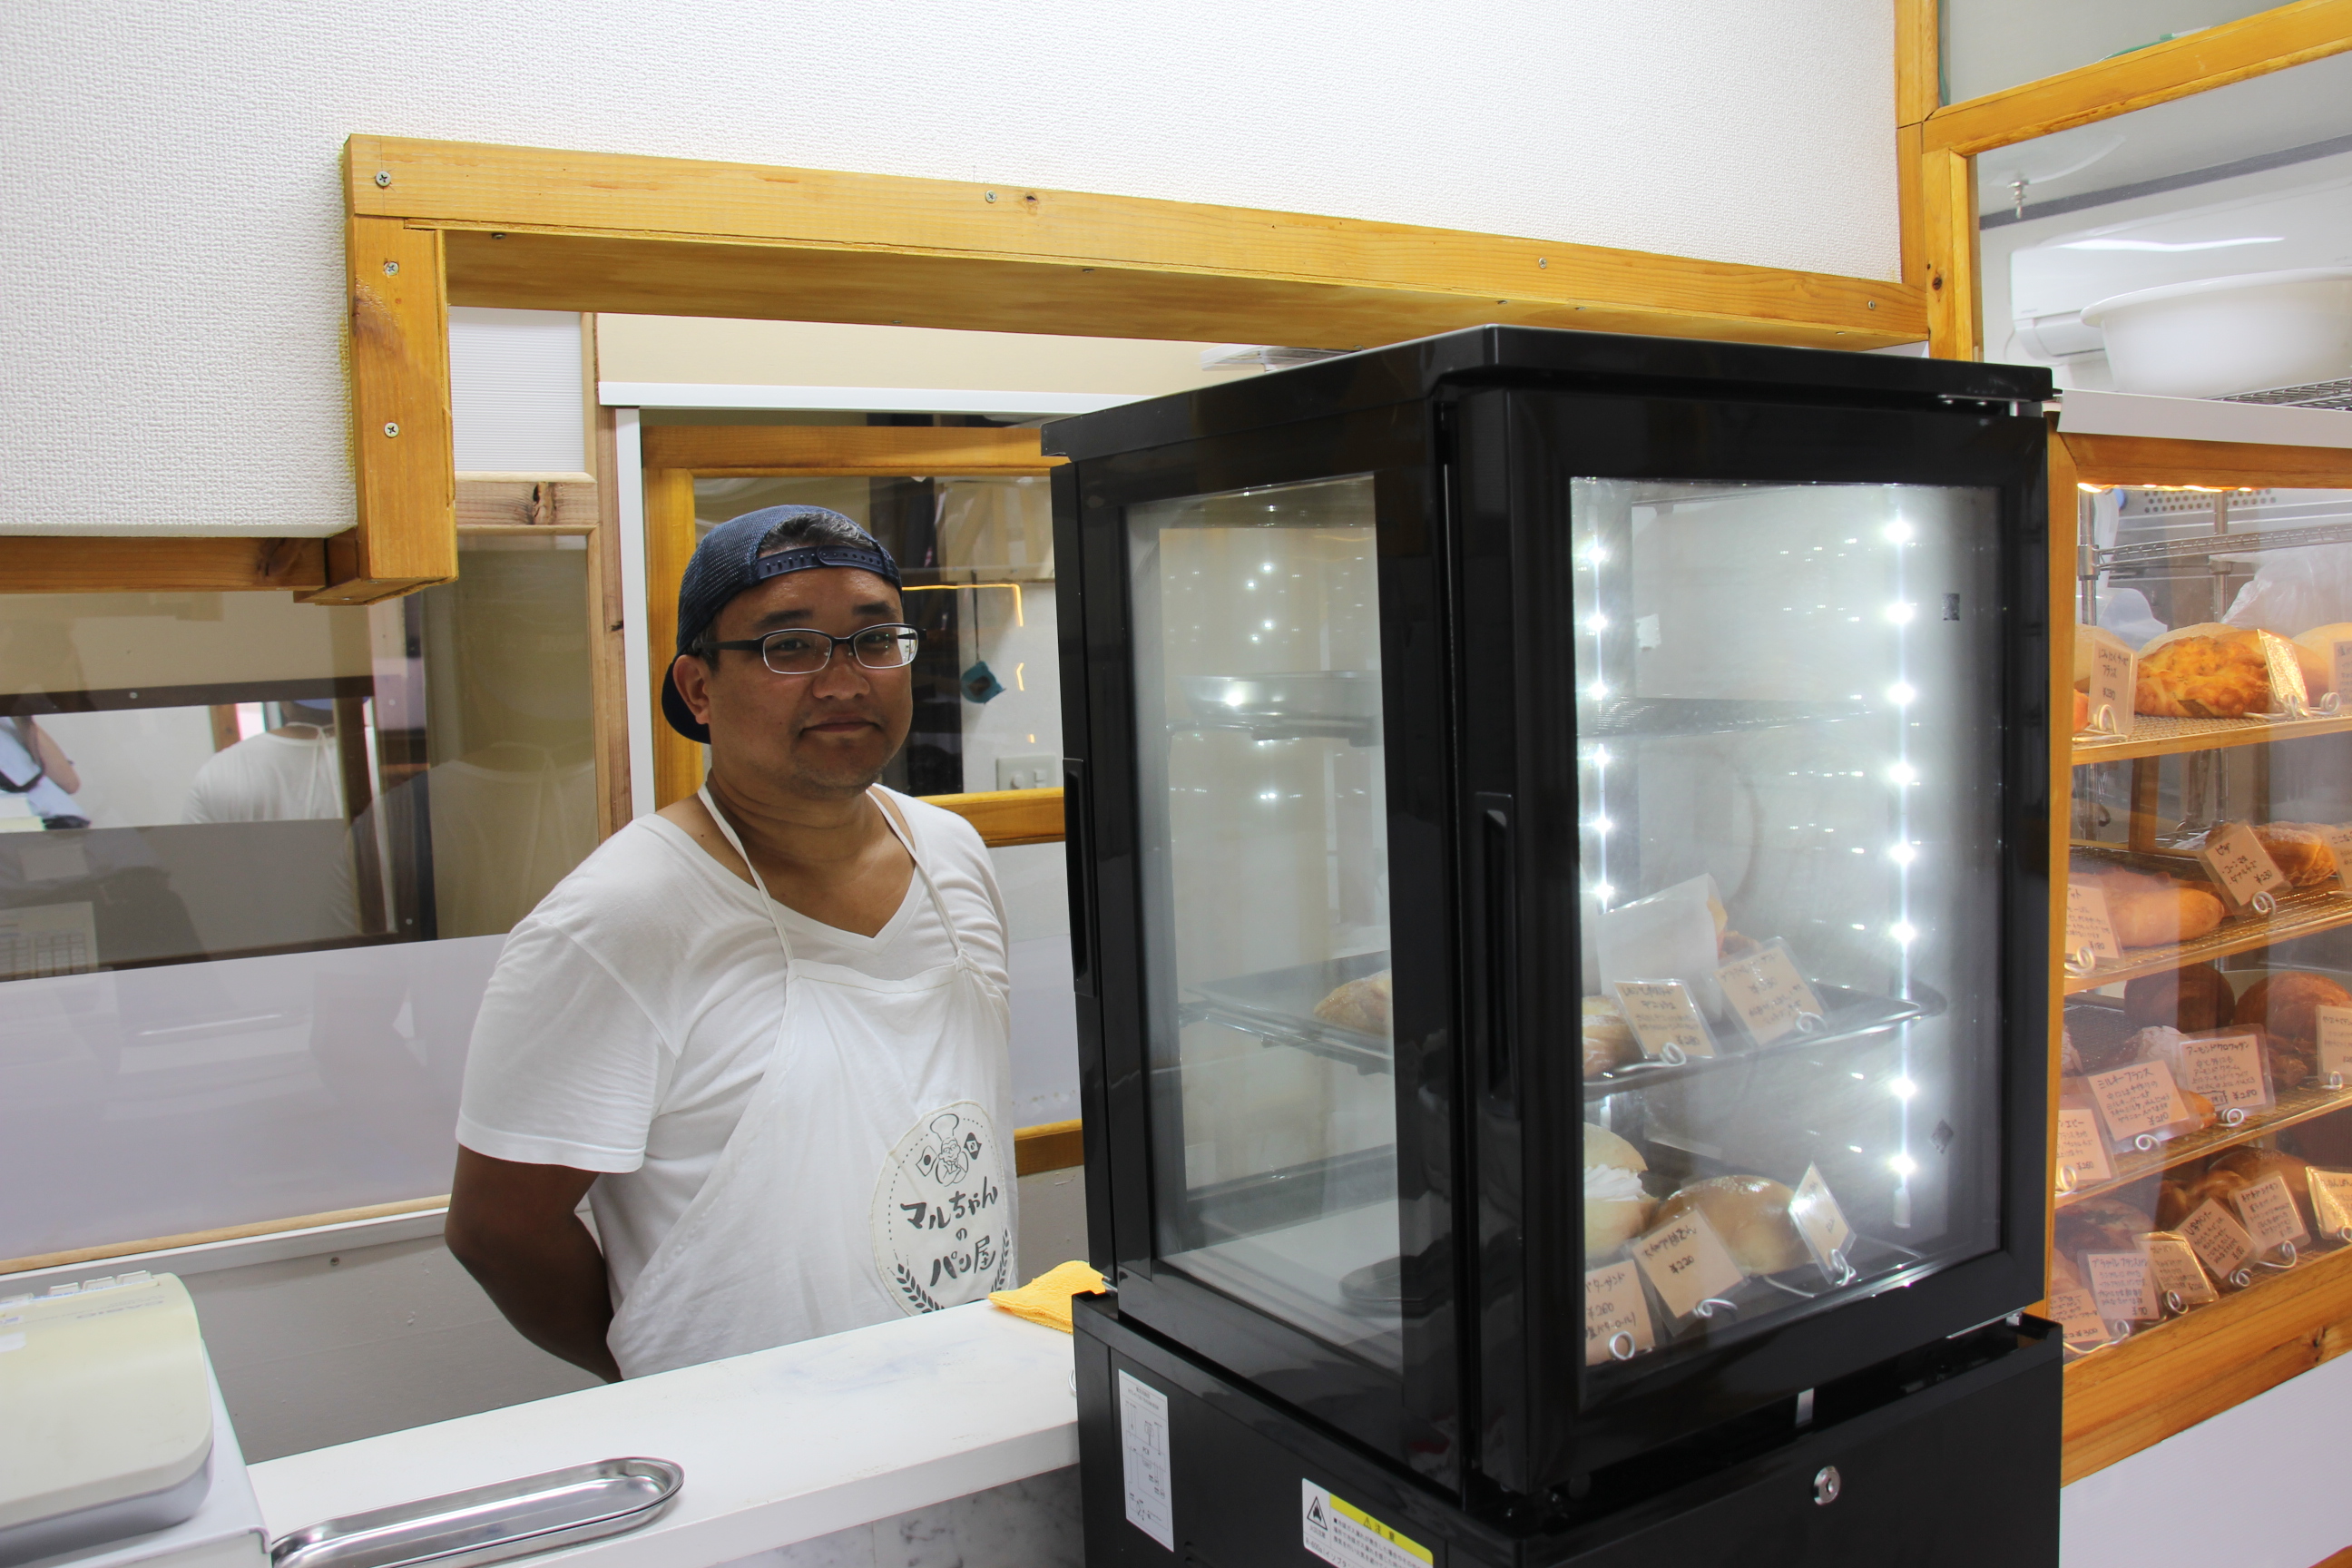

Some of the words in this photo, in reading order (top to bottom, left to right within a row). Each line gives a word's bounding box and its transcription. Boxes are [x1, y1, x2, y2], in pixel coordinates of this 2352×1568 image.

[2097, 1067, 2154, 1090] ミルキーフランス
[2232, 1089, 2258, 1101] ¥280
[2147, 1112, 2169, 1126] ¥210
[900, 1176, 998, 1230] マルちゃん
[956, 1228, 967, 1240] の
[929, 1235, 996, 1287] パン屋
[1669, 1255, 1695, 1274] ¥220
